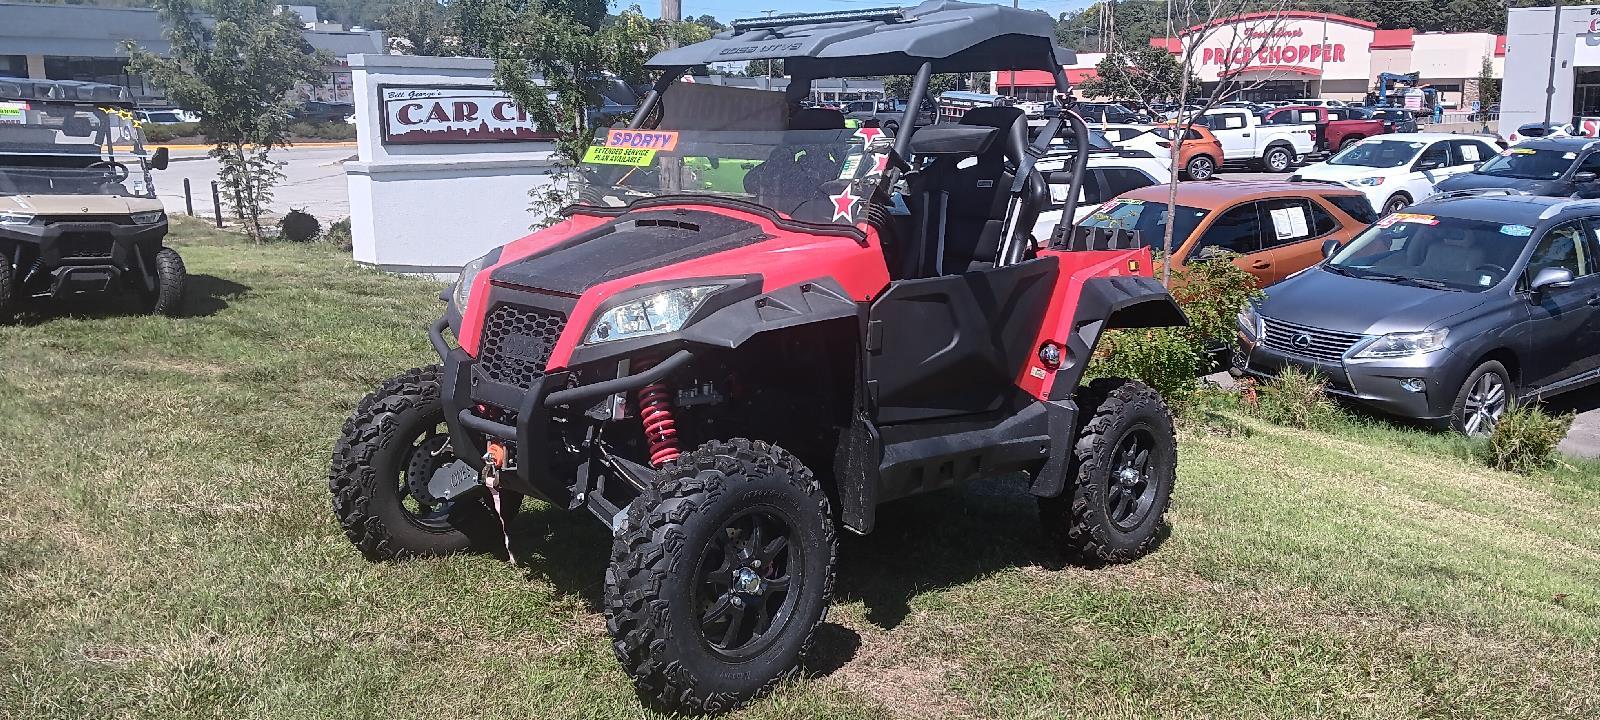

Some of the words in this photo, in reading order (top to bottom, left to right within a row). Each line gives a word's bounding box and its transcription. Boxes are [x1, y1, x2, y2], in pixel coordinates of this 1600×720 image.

[1203, 47, 1252, 65] PRICE
[1257, 43, 1346, 64] CHOPPER
[387, 91, 405, 99] Bill
[407, 89, 442, 99] George's
[395, 100, 480, 126] CAR
[610, 131, 672, 148] SPORTY
[593, 147, 623, 156] EXTENDED
[609, 155, 643, 164] AVAILABLE
